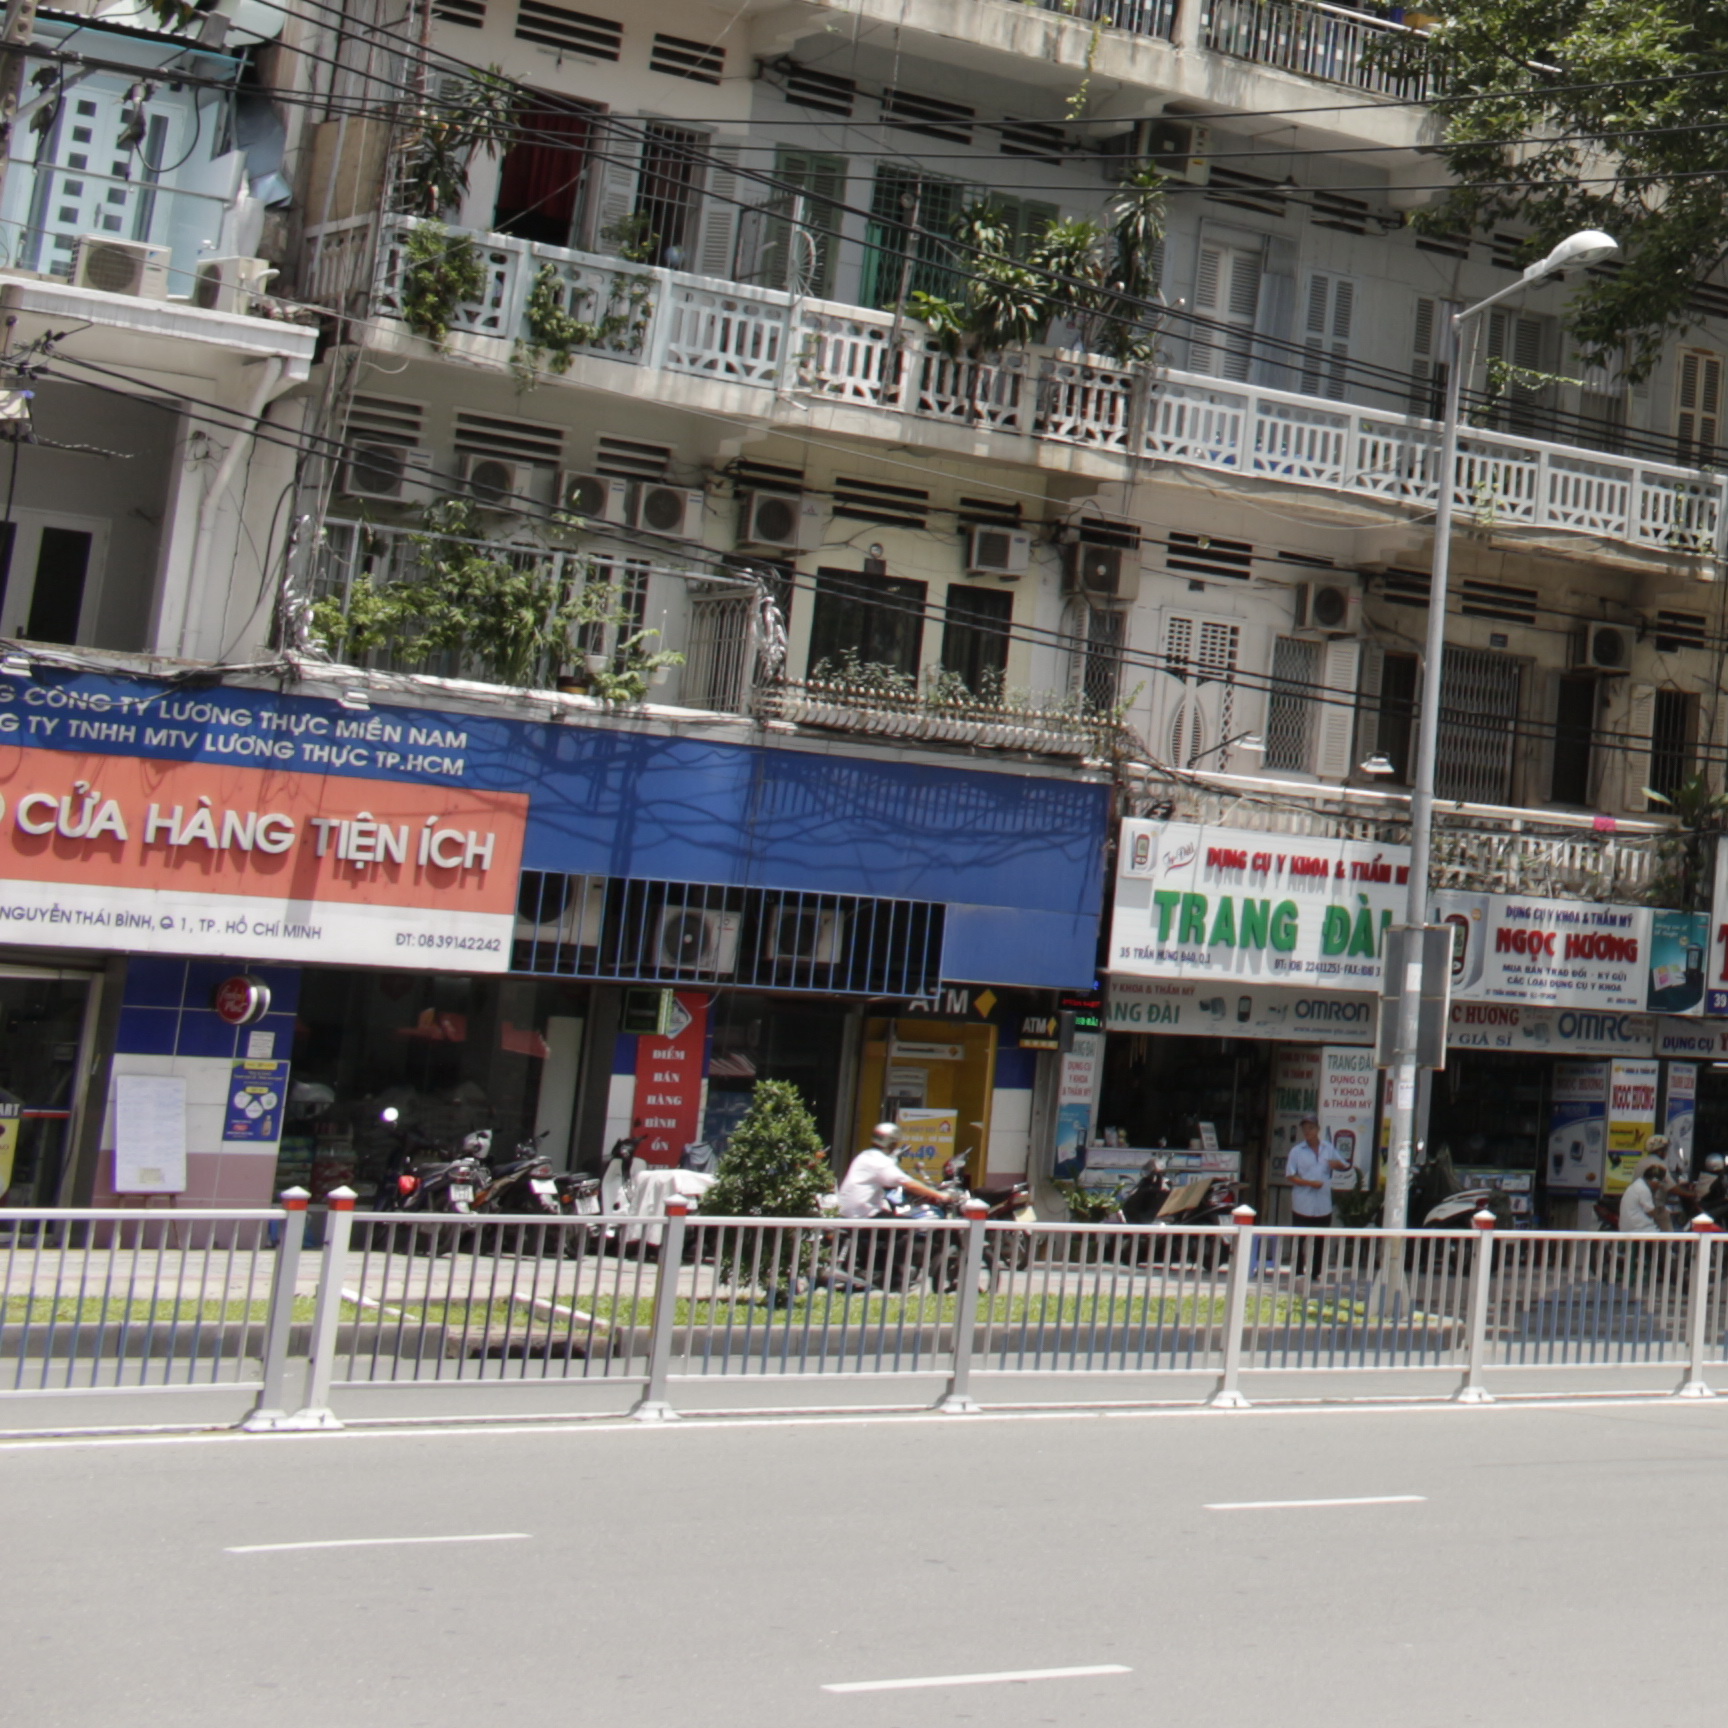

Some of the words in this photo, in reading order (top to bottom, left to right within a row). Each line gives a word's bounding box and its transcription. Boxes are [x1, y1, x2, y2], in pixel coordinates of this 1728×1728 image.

[24, 686, 112, 711] CÔNG
[121, 696, 151, 715] TY
[159, 700, 252, 726] LƯƠNG
[260, 711, 329, 736] THỰC
[409, 728, 467, 749] NAM
[28, 715, 60, 735] TY
[68, 720, 136, 743] TNHH
[144, 727, 198, 749] MTV
[205, 733, 295, 759] LƯƠNG
[302, 743, 369, 767] THỰC
[375, 751, 465, 776] TP.HCM
[17, 780, 128, 841] CỬA
[145, 795, 295, 854] HÀNG
[310, 811, 409, 869] TIỆN
[418, 815, 495, 870] ÍCH
[1207, 847, 1247, 872] DỤNG
[1252, 852, 1272, 876] CỤ
[1277, 854, 1287, 869] Y
[1290, 855, 1329, 877] KHOA
[1335, 860, 1345, 879] &
[1506, 905, 1530, 923] DỤNG
[1556, 909, 1580, 923] KHOA
[75, 908, 111, 926] THÁI
[115, 911, 155, 932] BÌNH,
[226, 914, 248, 934] HỒ
[253, 921, 279, 937] CHÍ
[283, 925, 321, 940] MINH
[418, 934, 501, 952] 0839142242
[1154, 890, 1298, 952] TRANG
[1322, 893, 1393, 959] ĐÀI
[1120, 947, 1130, 958] 35
[1496, 927, 1556, 962] NGỌC
[1565, 930, 1638, 963] HƯƠNG
[909, 987, 969, 1014] ATM
[1714, 993, 1726, 1007] 39
[1147, 999, 1180, 1024] ĐÀI
[1295, 999, 1370, 1022] OMRON
[1466, 1006, 1520, 1025] HƯƠNG
[1022, 1017, 1047, 1033] ATM
[1459, 1029, 1489, 1046] GIÁ
[1663, 1036, 1695, 1051] DỤNG
[1698, 1038, 1713, 1052] CỤ
[1328, 1054, 1357, 1070] TRANG
[653, 1071, 680, 1083] BÁN
[1330, 1075, 1355, 1086] DỤNG
[1357, 1075, 1369, 1087] CỤ
[646, 1094, 682, 1106] HÀNG
[1340, 1088, 1364, 1097] KHOA
[644, 1117, 676, 1129] BÌNH
